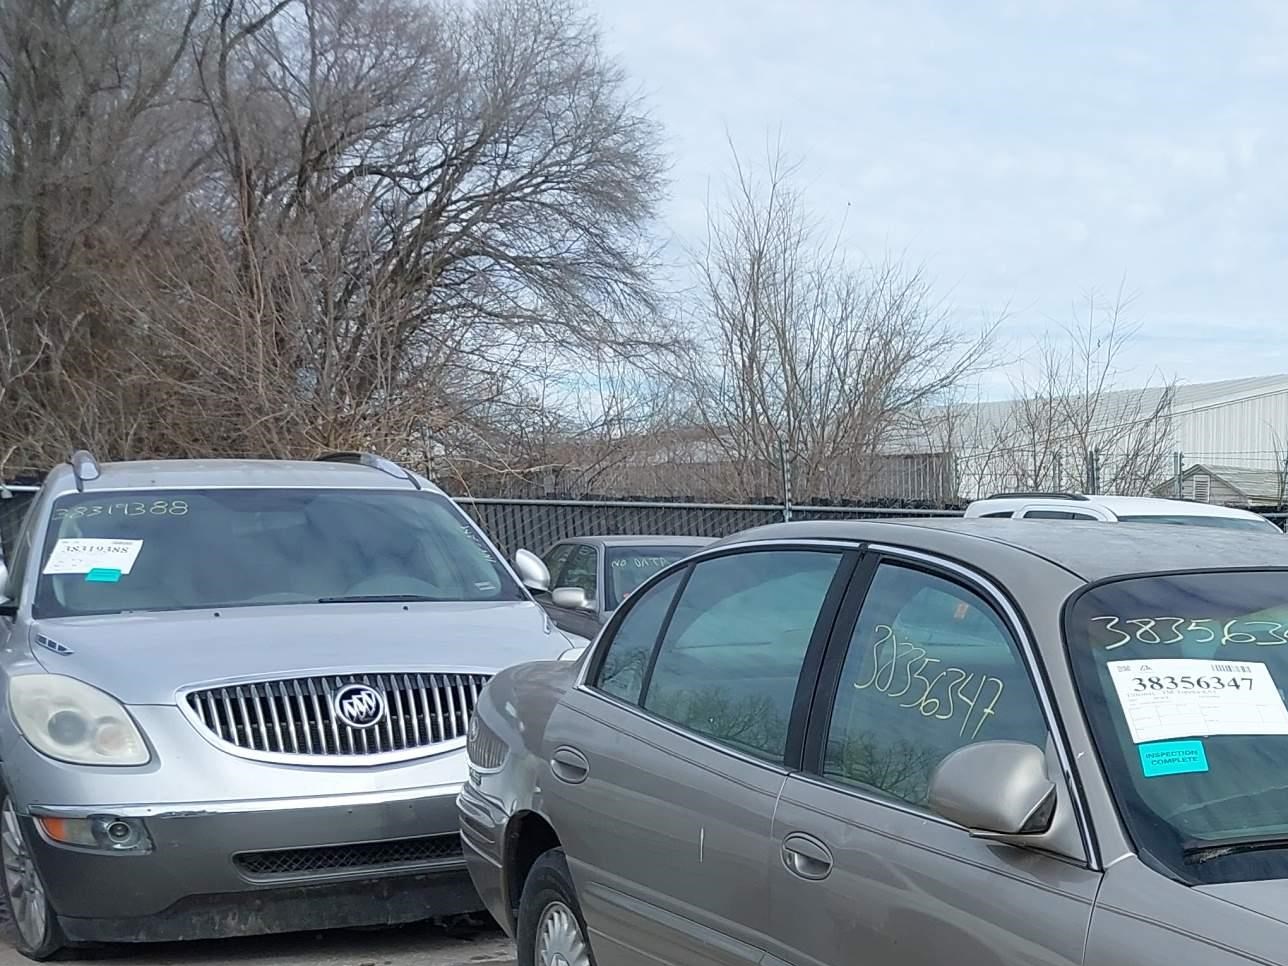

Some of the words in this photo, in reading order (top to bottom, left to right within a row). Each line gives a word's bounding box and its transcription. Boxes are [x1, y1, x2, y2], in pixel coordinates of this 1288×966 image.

[853, 624, 1004, 740] 38356347
[1131, 675, 1254, 693] 38356347
[1145, 750, 1199, 759] INSPECTION
[1151, 756, 1199, 766] COMPLETE
